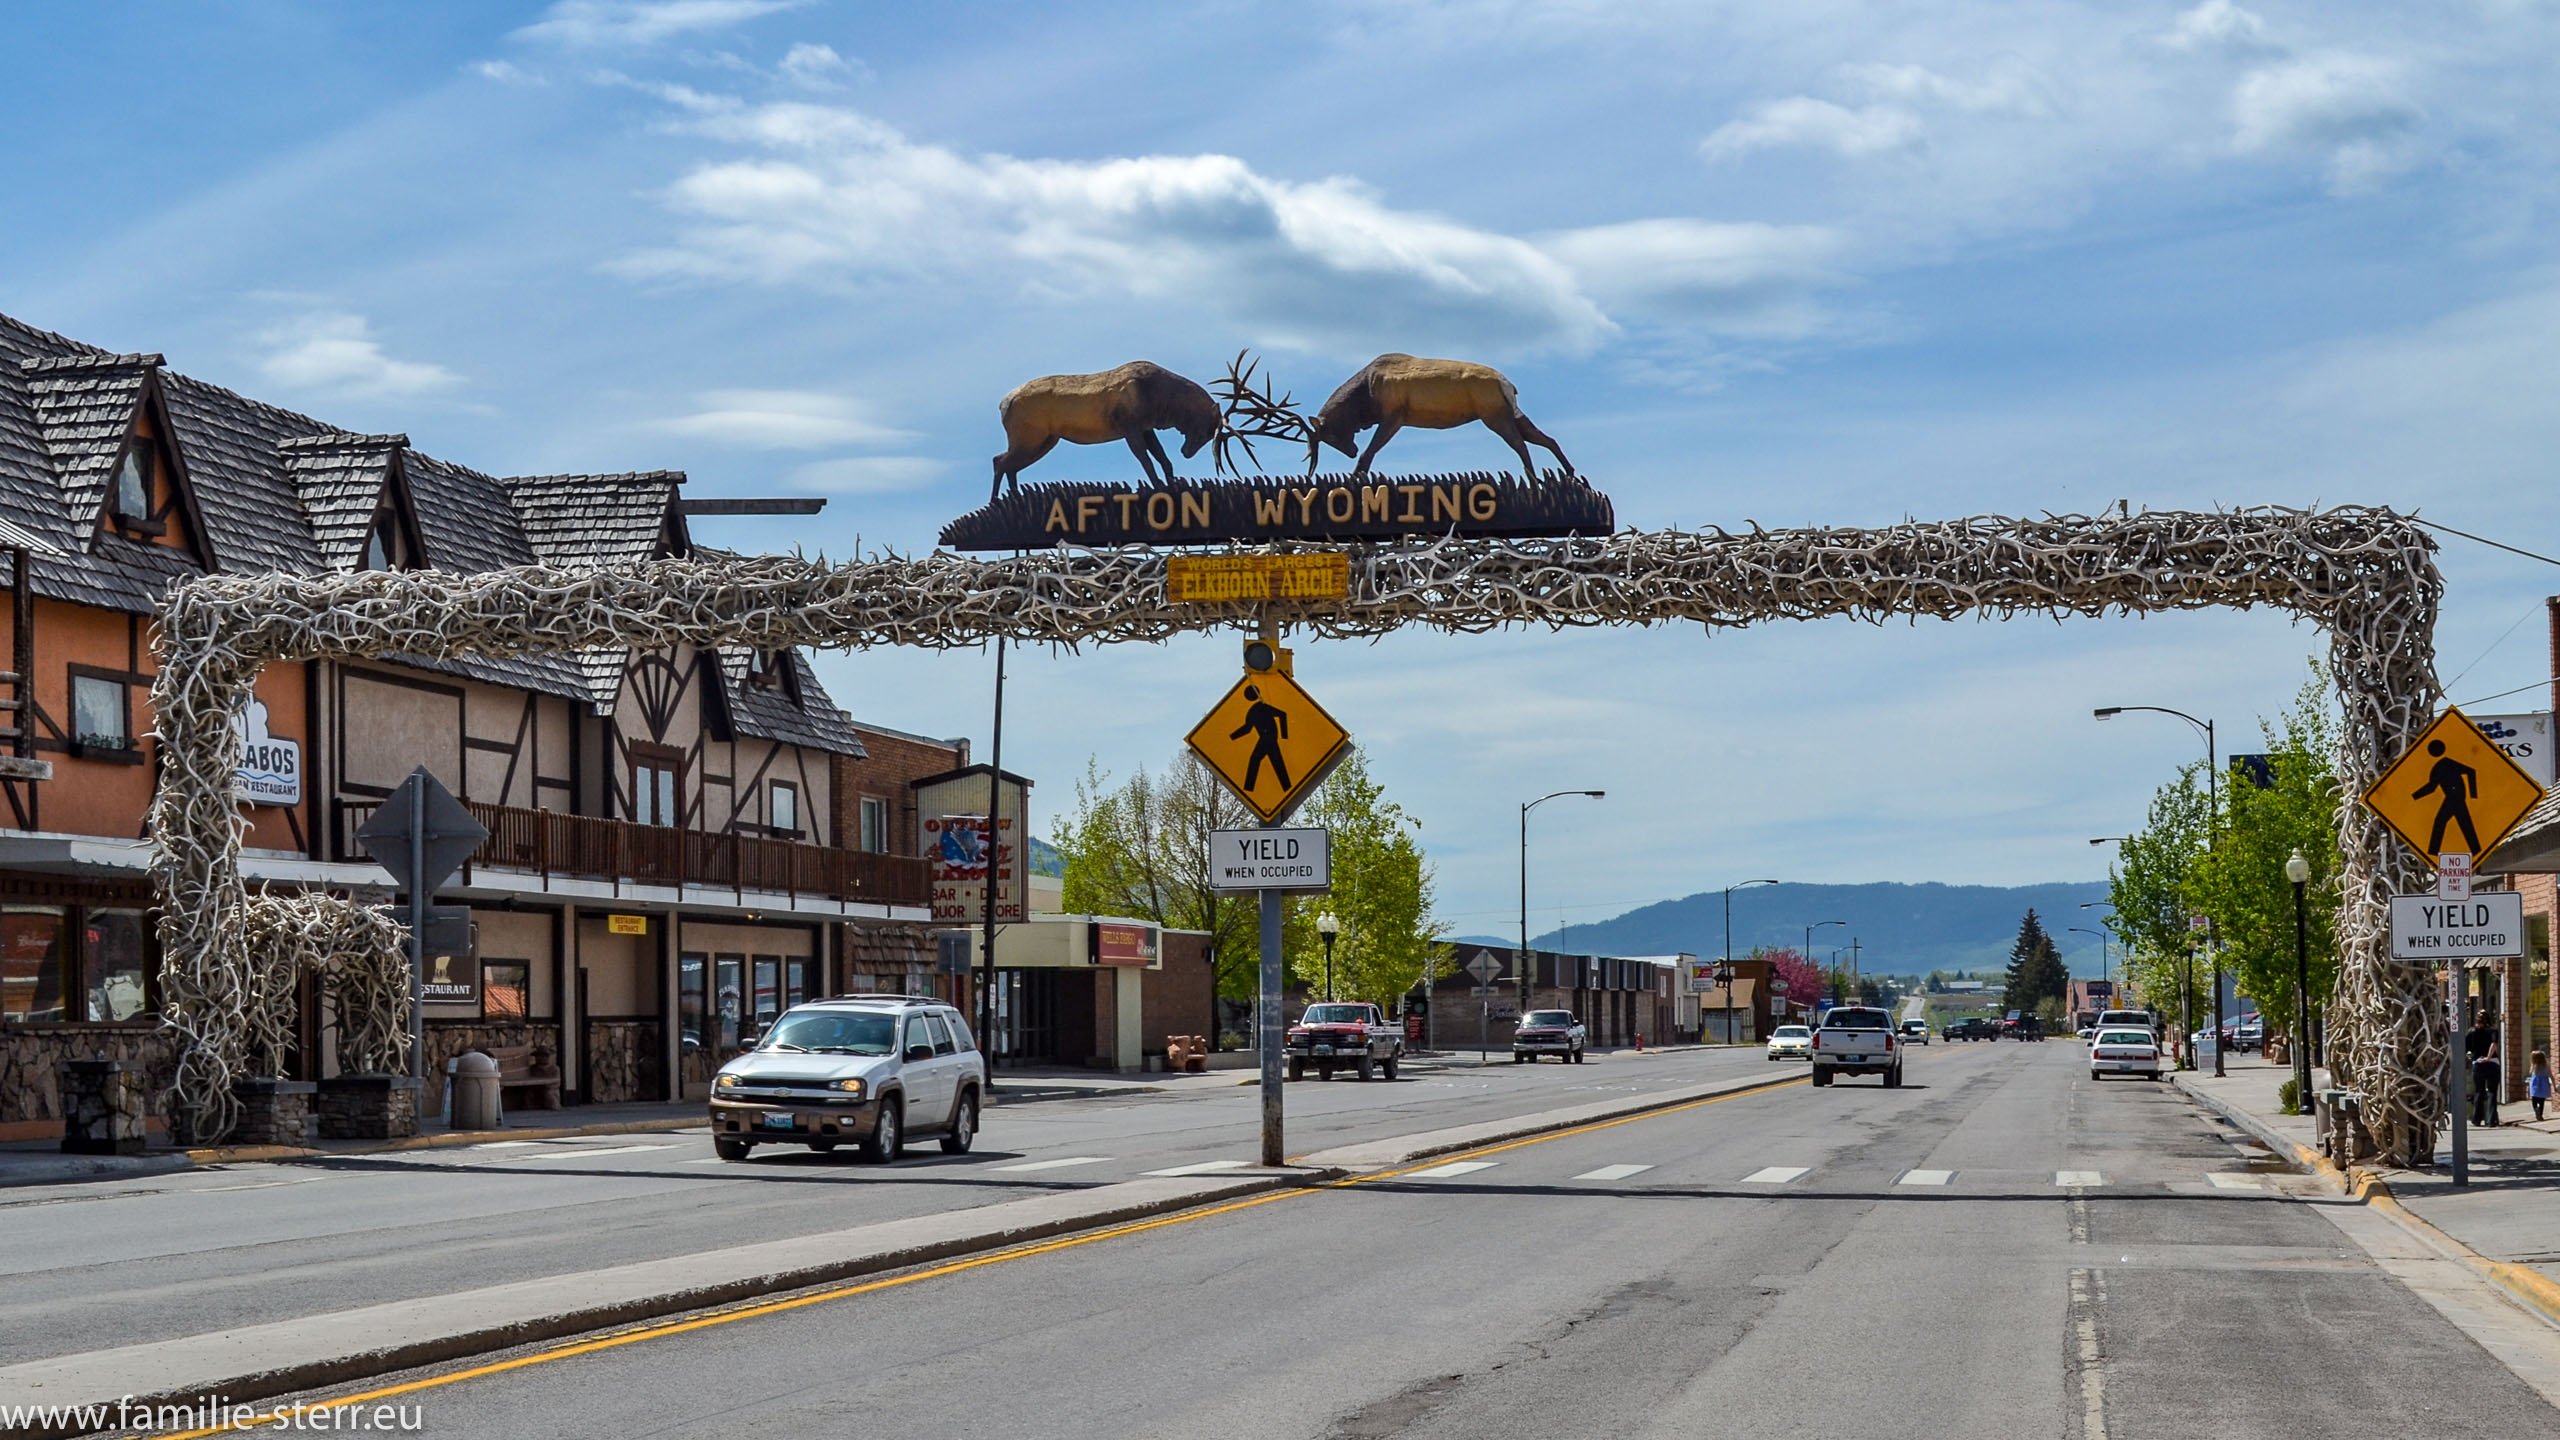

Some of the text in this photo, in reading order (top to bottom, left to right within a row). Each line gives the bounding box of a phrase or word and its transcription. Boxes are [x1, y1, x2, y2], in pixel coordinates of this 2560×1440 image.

[1045, 483, 1498, 533] AFTON WYOMING
[1187, 555, 1332, 571] WORLD'S LARGEST
[1182, 568, 1333, 600] ELKHORN ARCH
[236, 745, 294, 775] ABOS
[251, 781, 297, 796] RESTAURANT
[1239, 839, 1299, 860] YIELD
[2449, 858, 2461, 867] NO
[1225, 866, 1313, 878] WHEN OCCUPIED
[2440, 868, 2470, 877] PARKING
[980, 888, 1008, 900] DLI
[980, 904, 1020, 917] SORE
[2422, 904, 2490, 928] YIELD
[2408, 934, 2506, 948] WHEN OCCUPIED
